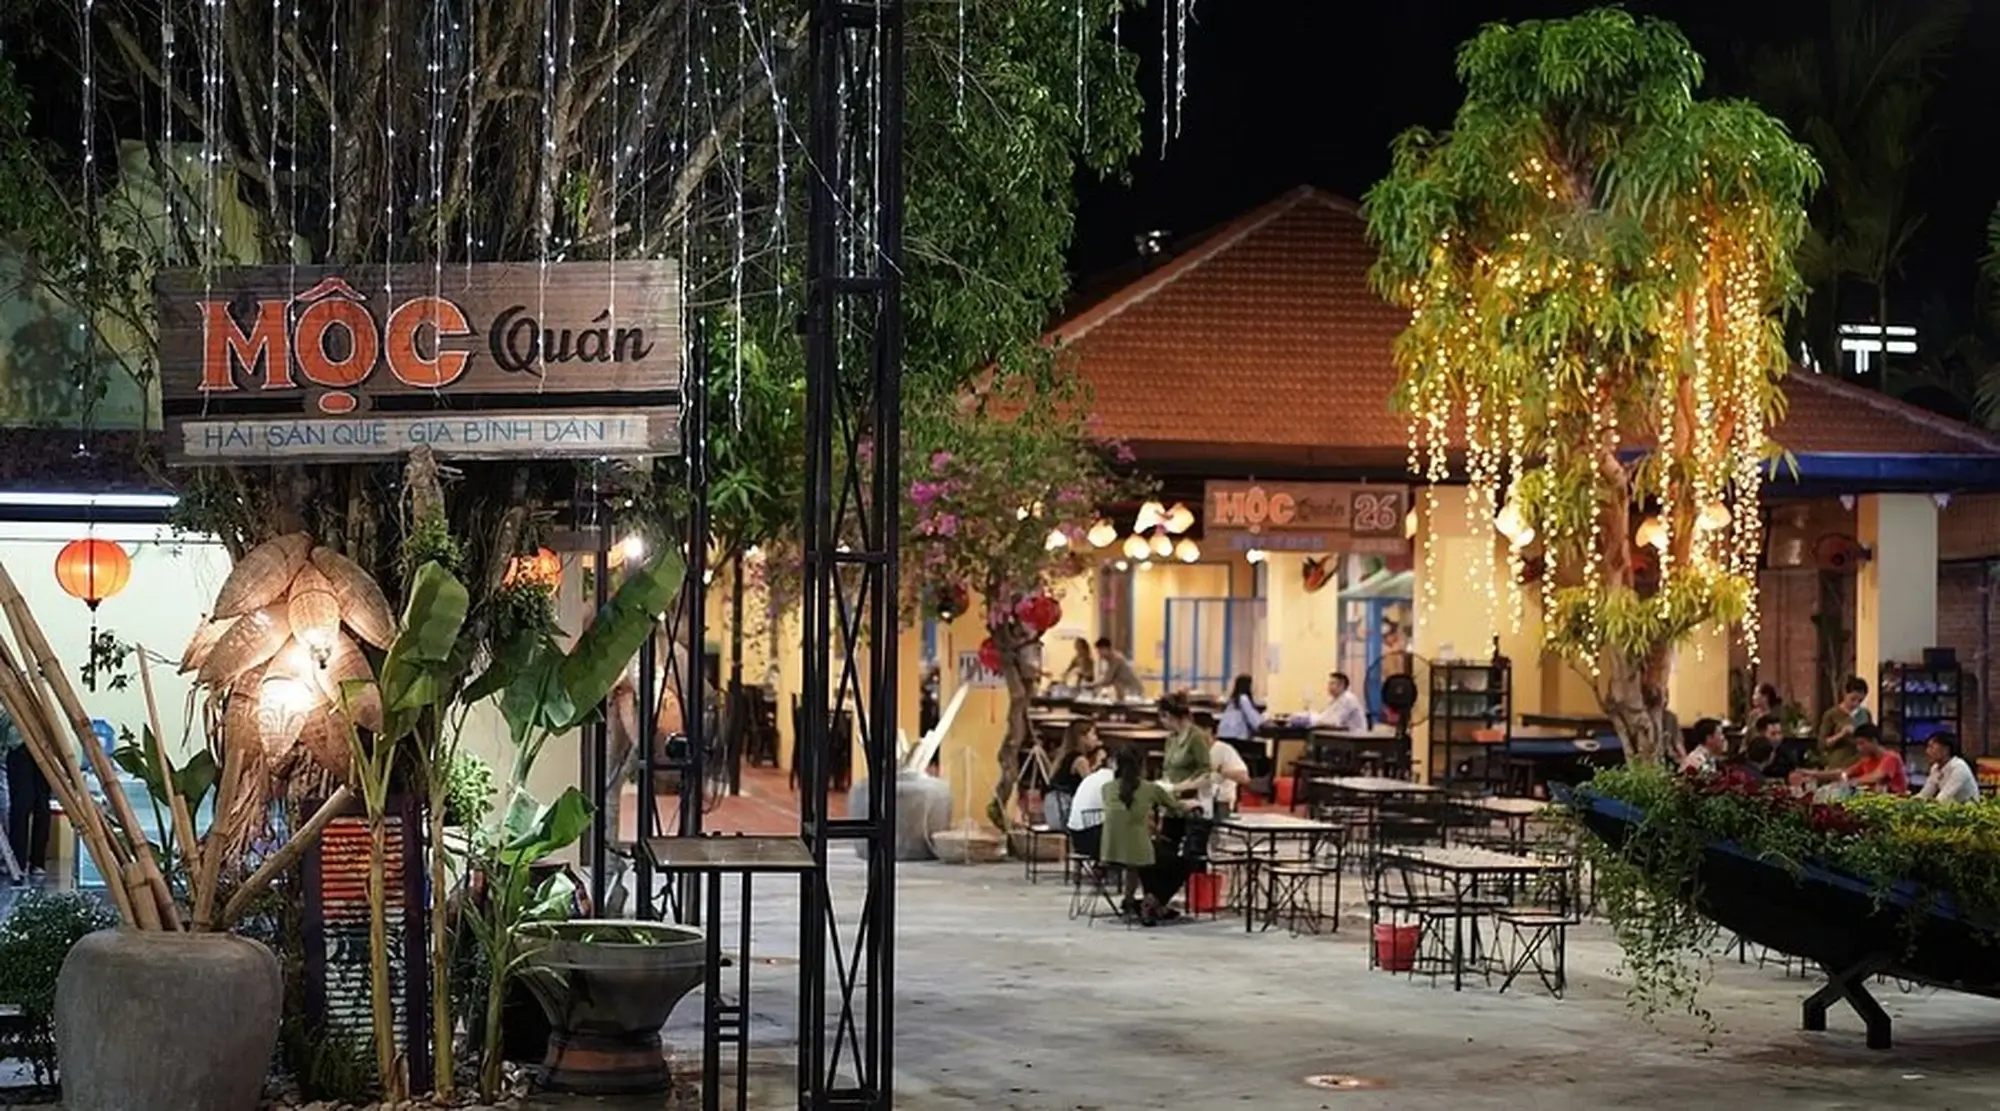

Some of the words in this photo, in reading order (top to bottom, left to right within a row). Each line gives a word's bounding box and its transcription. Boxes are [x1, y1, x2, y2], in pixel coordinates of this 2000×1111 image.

[197, 277, 473, 414] MỘC
[488, 305, 654, 375] Quán
[1212, 486, 1295, 534] MỘC
[1353, 493, 1398, 532] 26
